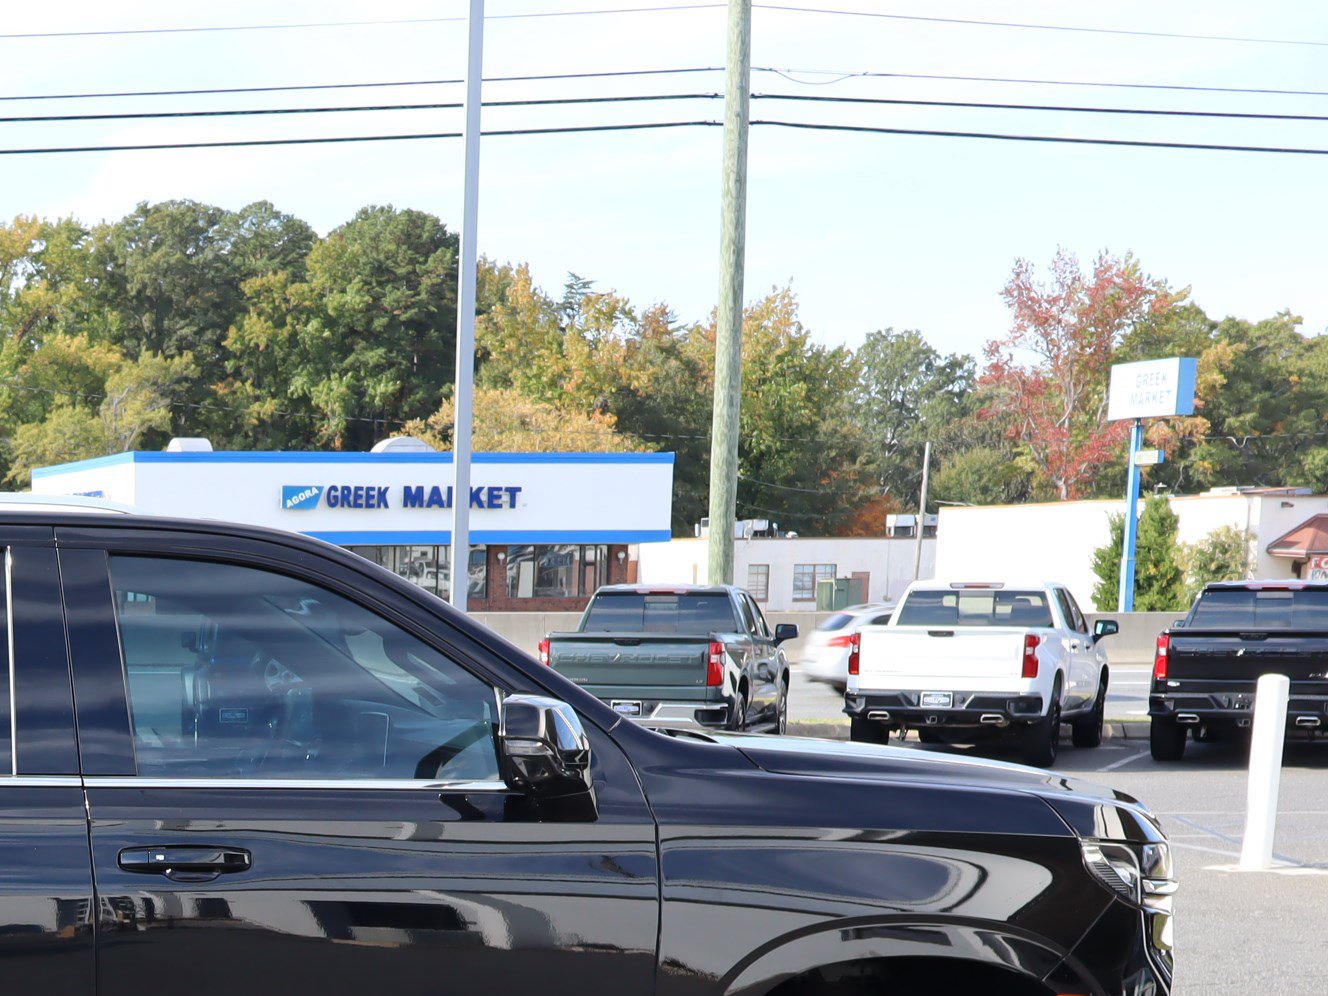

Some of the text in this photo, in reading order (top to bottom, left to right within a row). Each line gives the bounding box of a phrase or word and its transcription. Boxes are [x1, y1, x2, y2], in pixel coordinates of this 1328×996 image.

[1136, 372, 1168, 388] GREEK
[1130, 390, 1171, 406] MARKET
[285, 486, 319, 508] AGORA
[326, 485, 390, 509] GREEK
